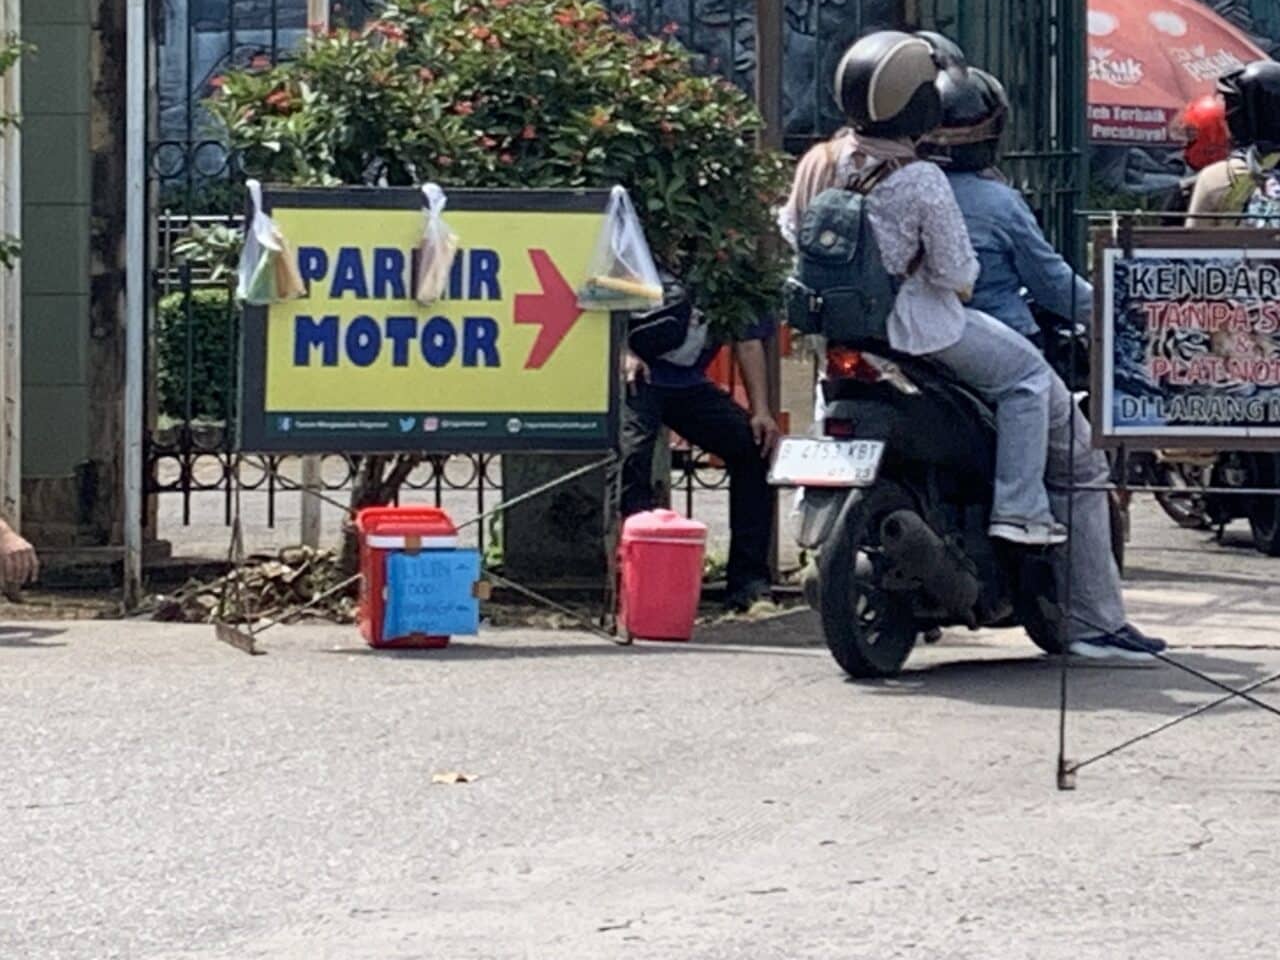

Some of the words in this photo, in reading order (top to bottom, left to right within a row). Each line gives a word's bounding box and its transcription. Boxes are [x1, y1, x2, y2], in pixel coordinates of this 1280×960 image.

[1143, 302, 1253, 331] TANPA
[294, 315, 501, 368] MOTOR
[1149, 359, 1220, 385] PLAT
[1120, 396, 1152, 420] DI
[1156, 397, 1264, 422] LARANG
